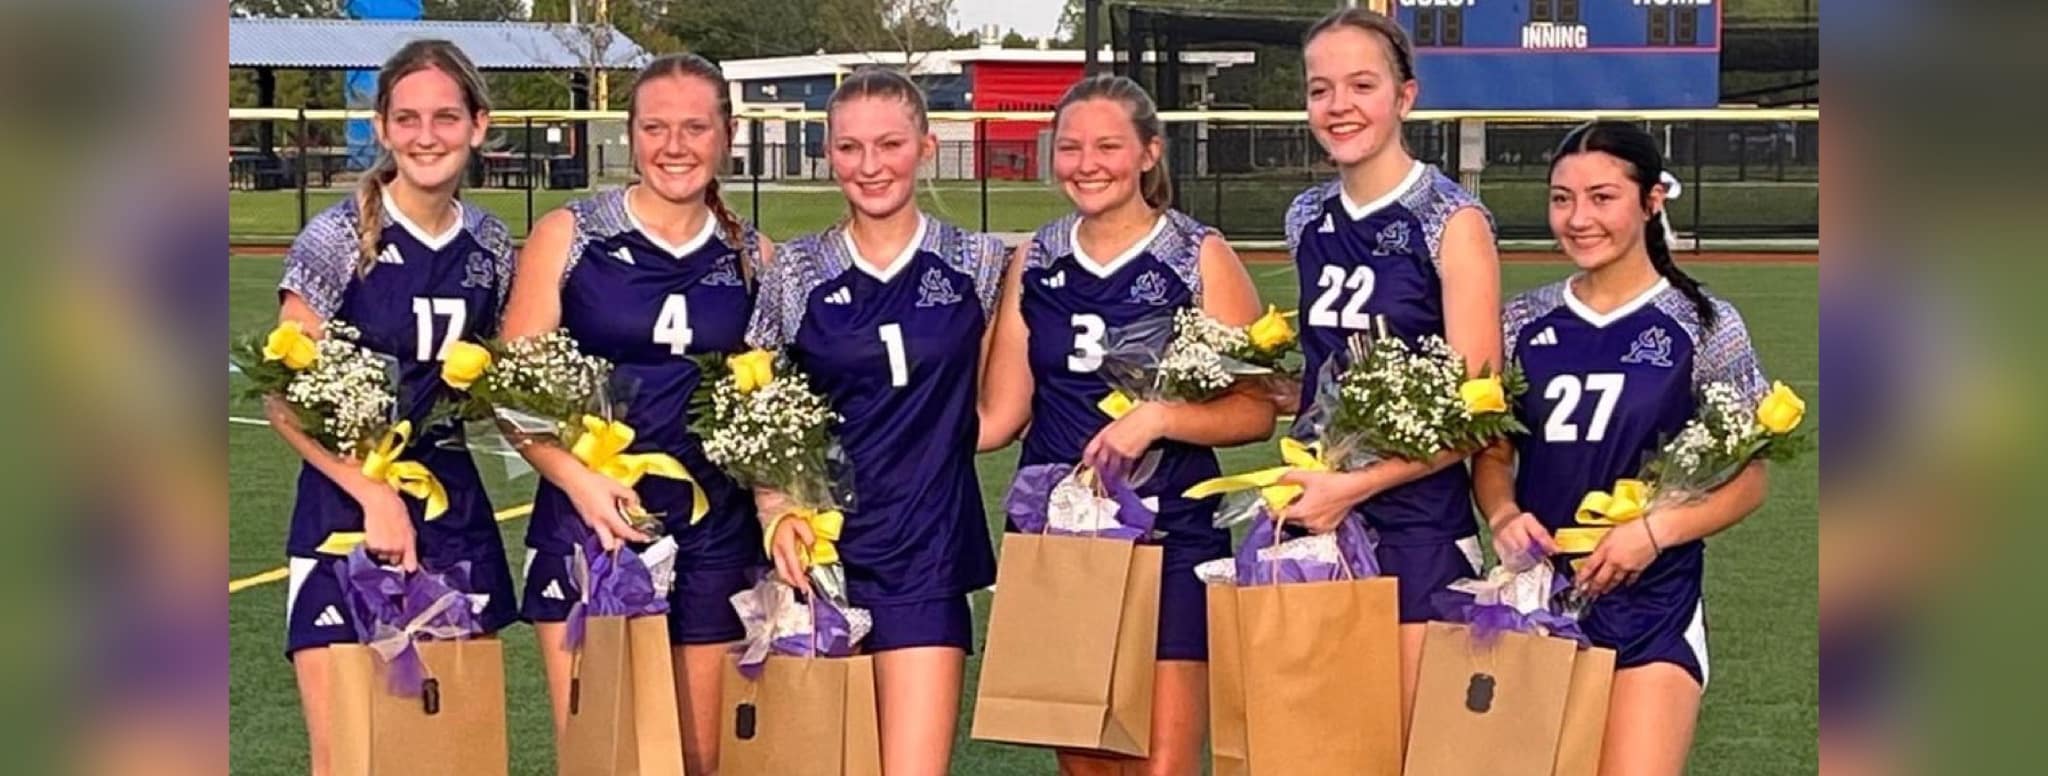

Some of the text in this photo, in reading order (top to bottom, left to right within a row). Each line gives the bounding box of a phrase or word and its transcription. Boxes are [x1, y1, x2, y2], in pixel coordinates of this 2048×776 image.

[1522, 25, 1588, 49] INNING
[412, 297, 467, 361] 17
[653, 294, 693, 355] 4
[1308, 265, 1375, 329] 22
[879, 323, 908, 387] 1
[1068, 314, 1109, 372] 3
[1544, 374, 1625, 441] 27
